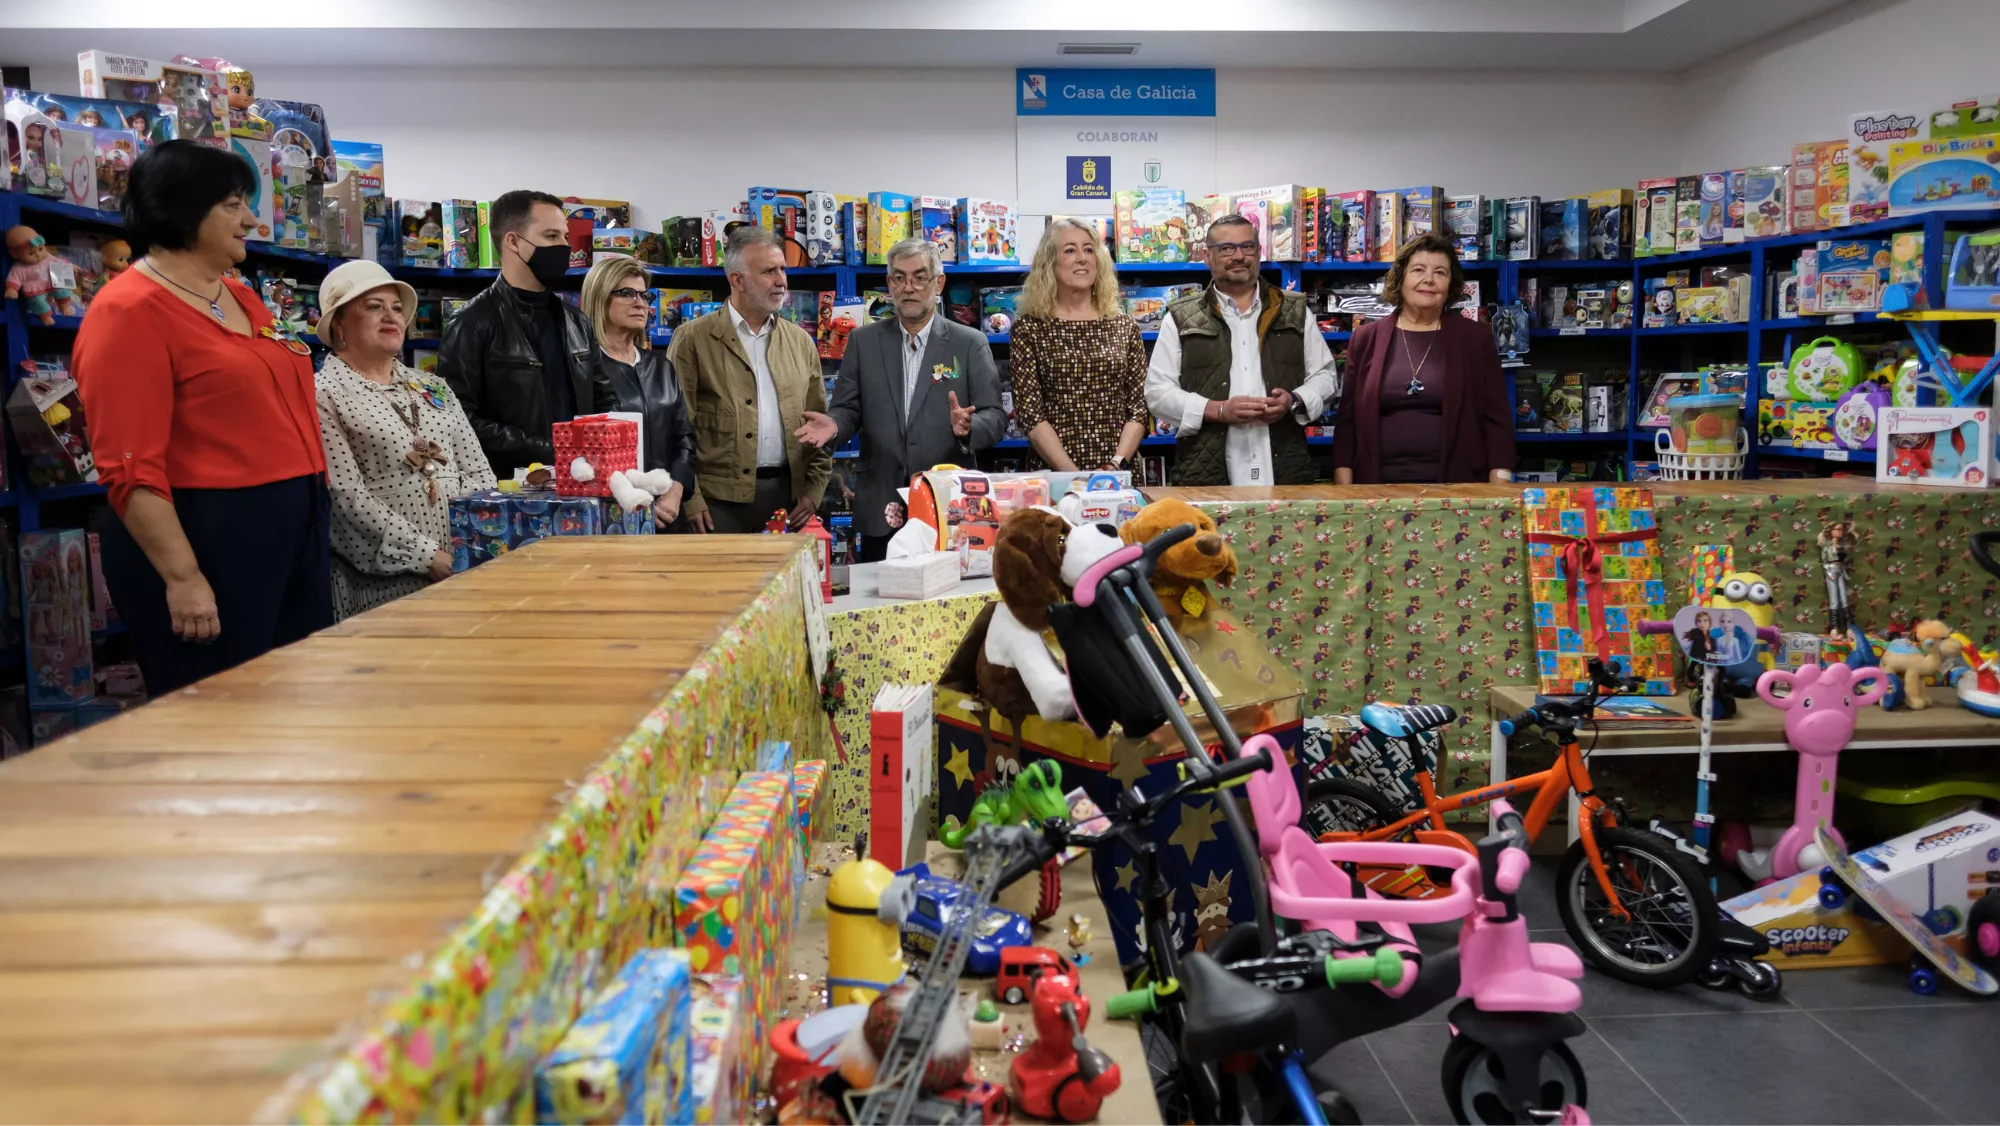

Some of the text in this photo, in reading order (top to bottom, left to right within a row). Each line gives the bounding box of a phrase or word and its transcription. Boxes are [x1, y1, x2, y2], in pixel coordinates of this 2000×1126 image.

[1063, 85, 1197, 100] Casa de Galicia
[1855, 117, 1914, 135] Plaster
[1077, 131, 1158, 142] COLABORAN
[1864, 130, 1906, 141] Painting
